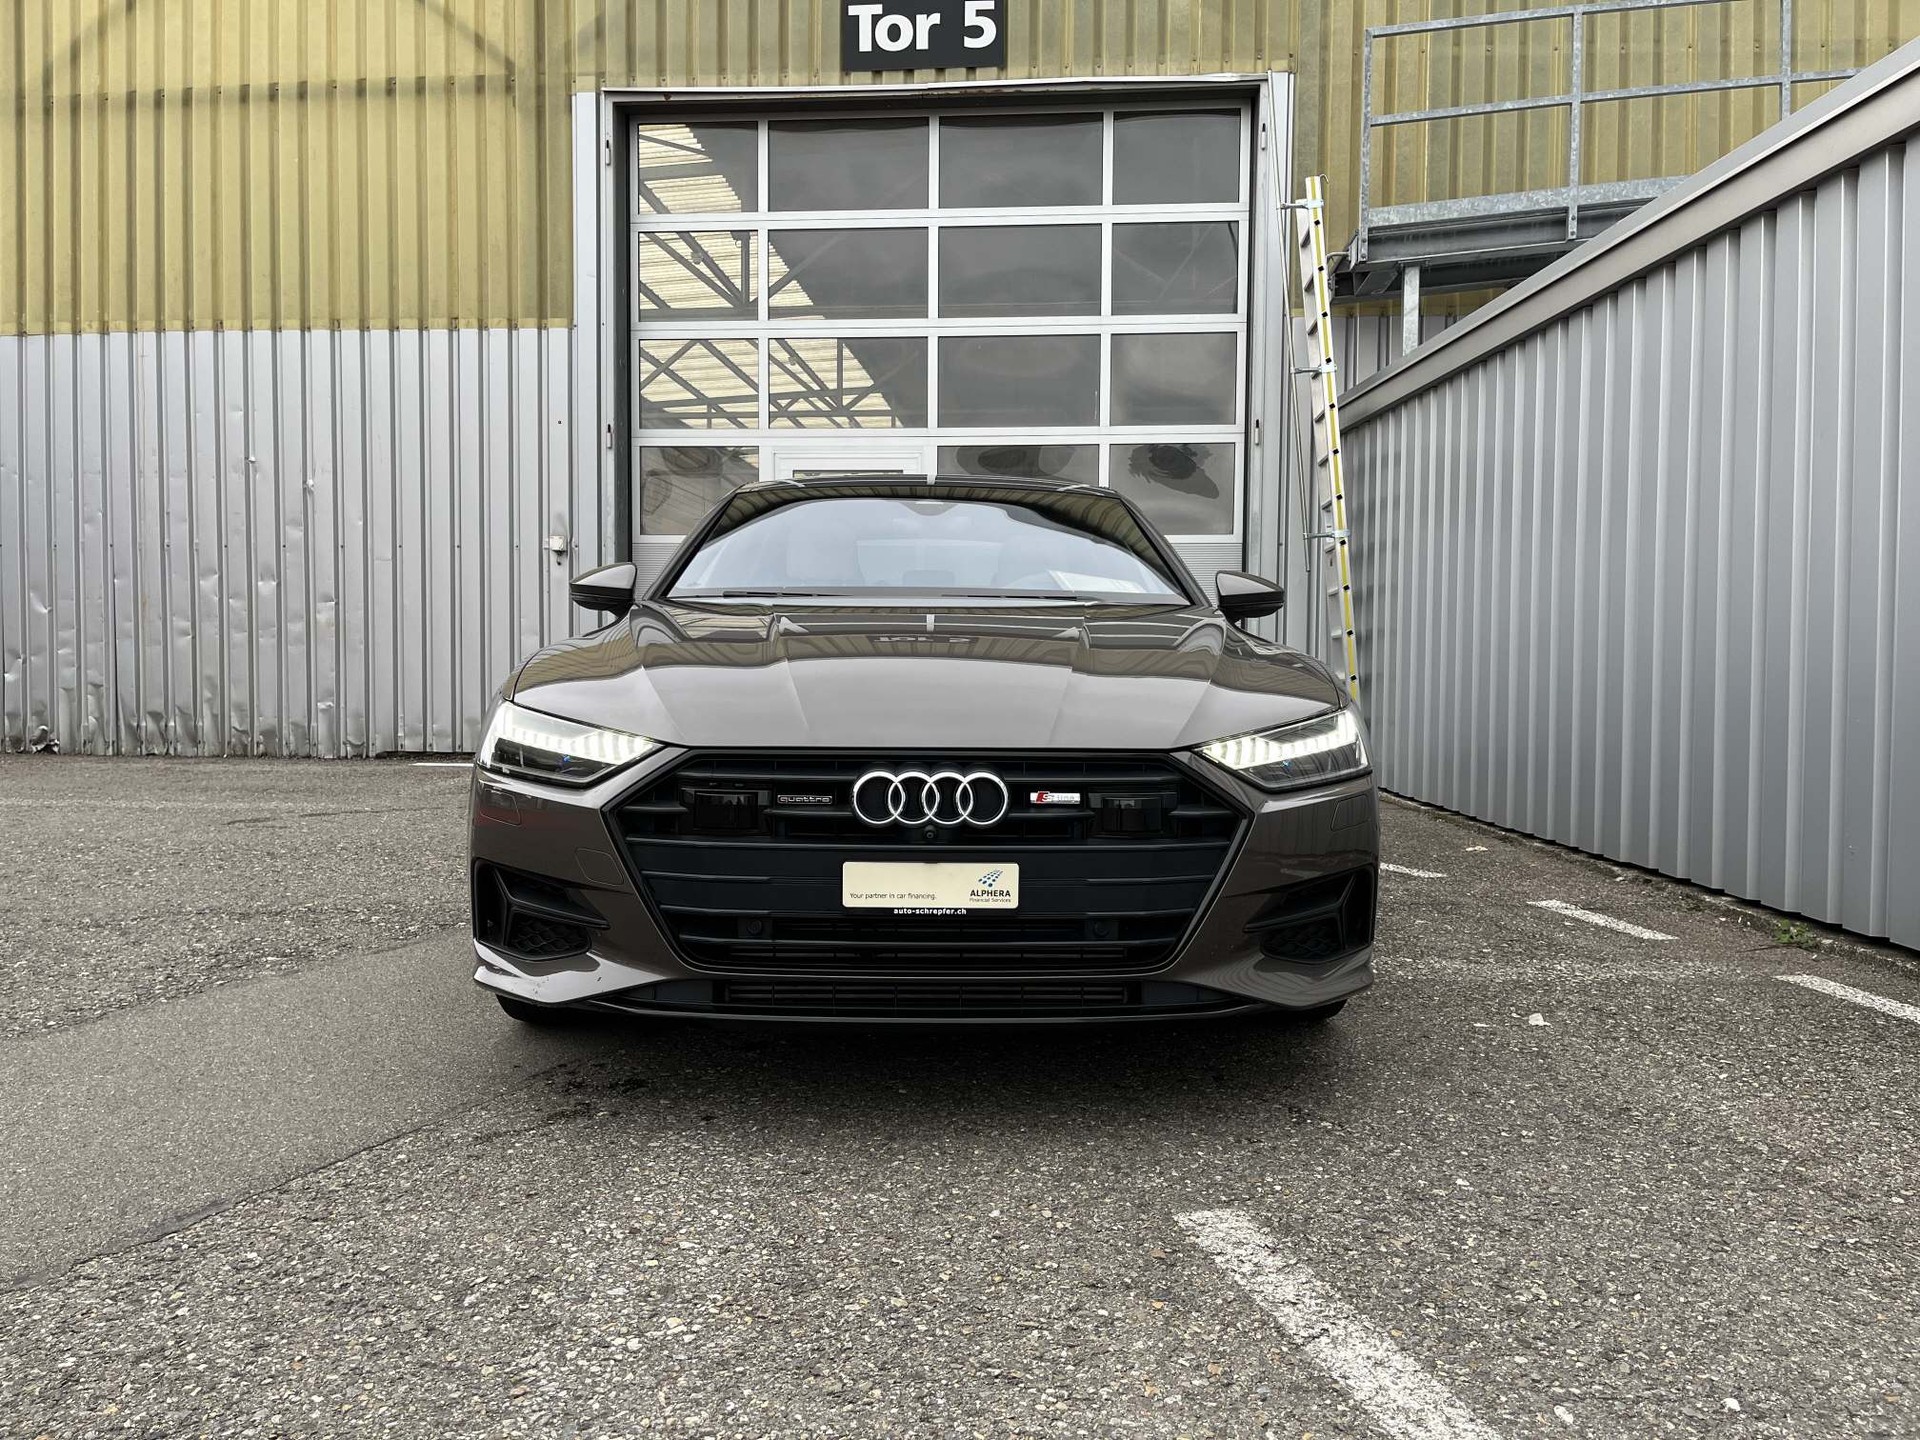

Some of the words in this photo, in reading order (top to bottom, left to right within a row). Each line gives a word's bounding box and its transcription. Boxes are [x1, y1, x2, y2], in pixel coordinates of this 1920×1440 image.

[848, 4, 941, 52] Tor
[963, 0, 997, 49] 5
[969, 889, 1012, 897] ALPHERA
[893, 907, 967, 916] auto-schrepfer.ch
